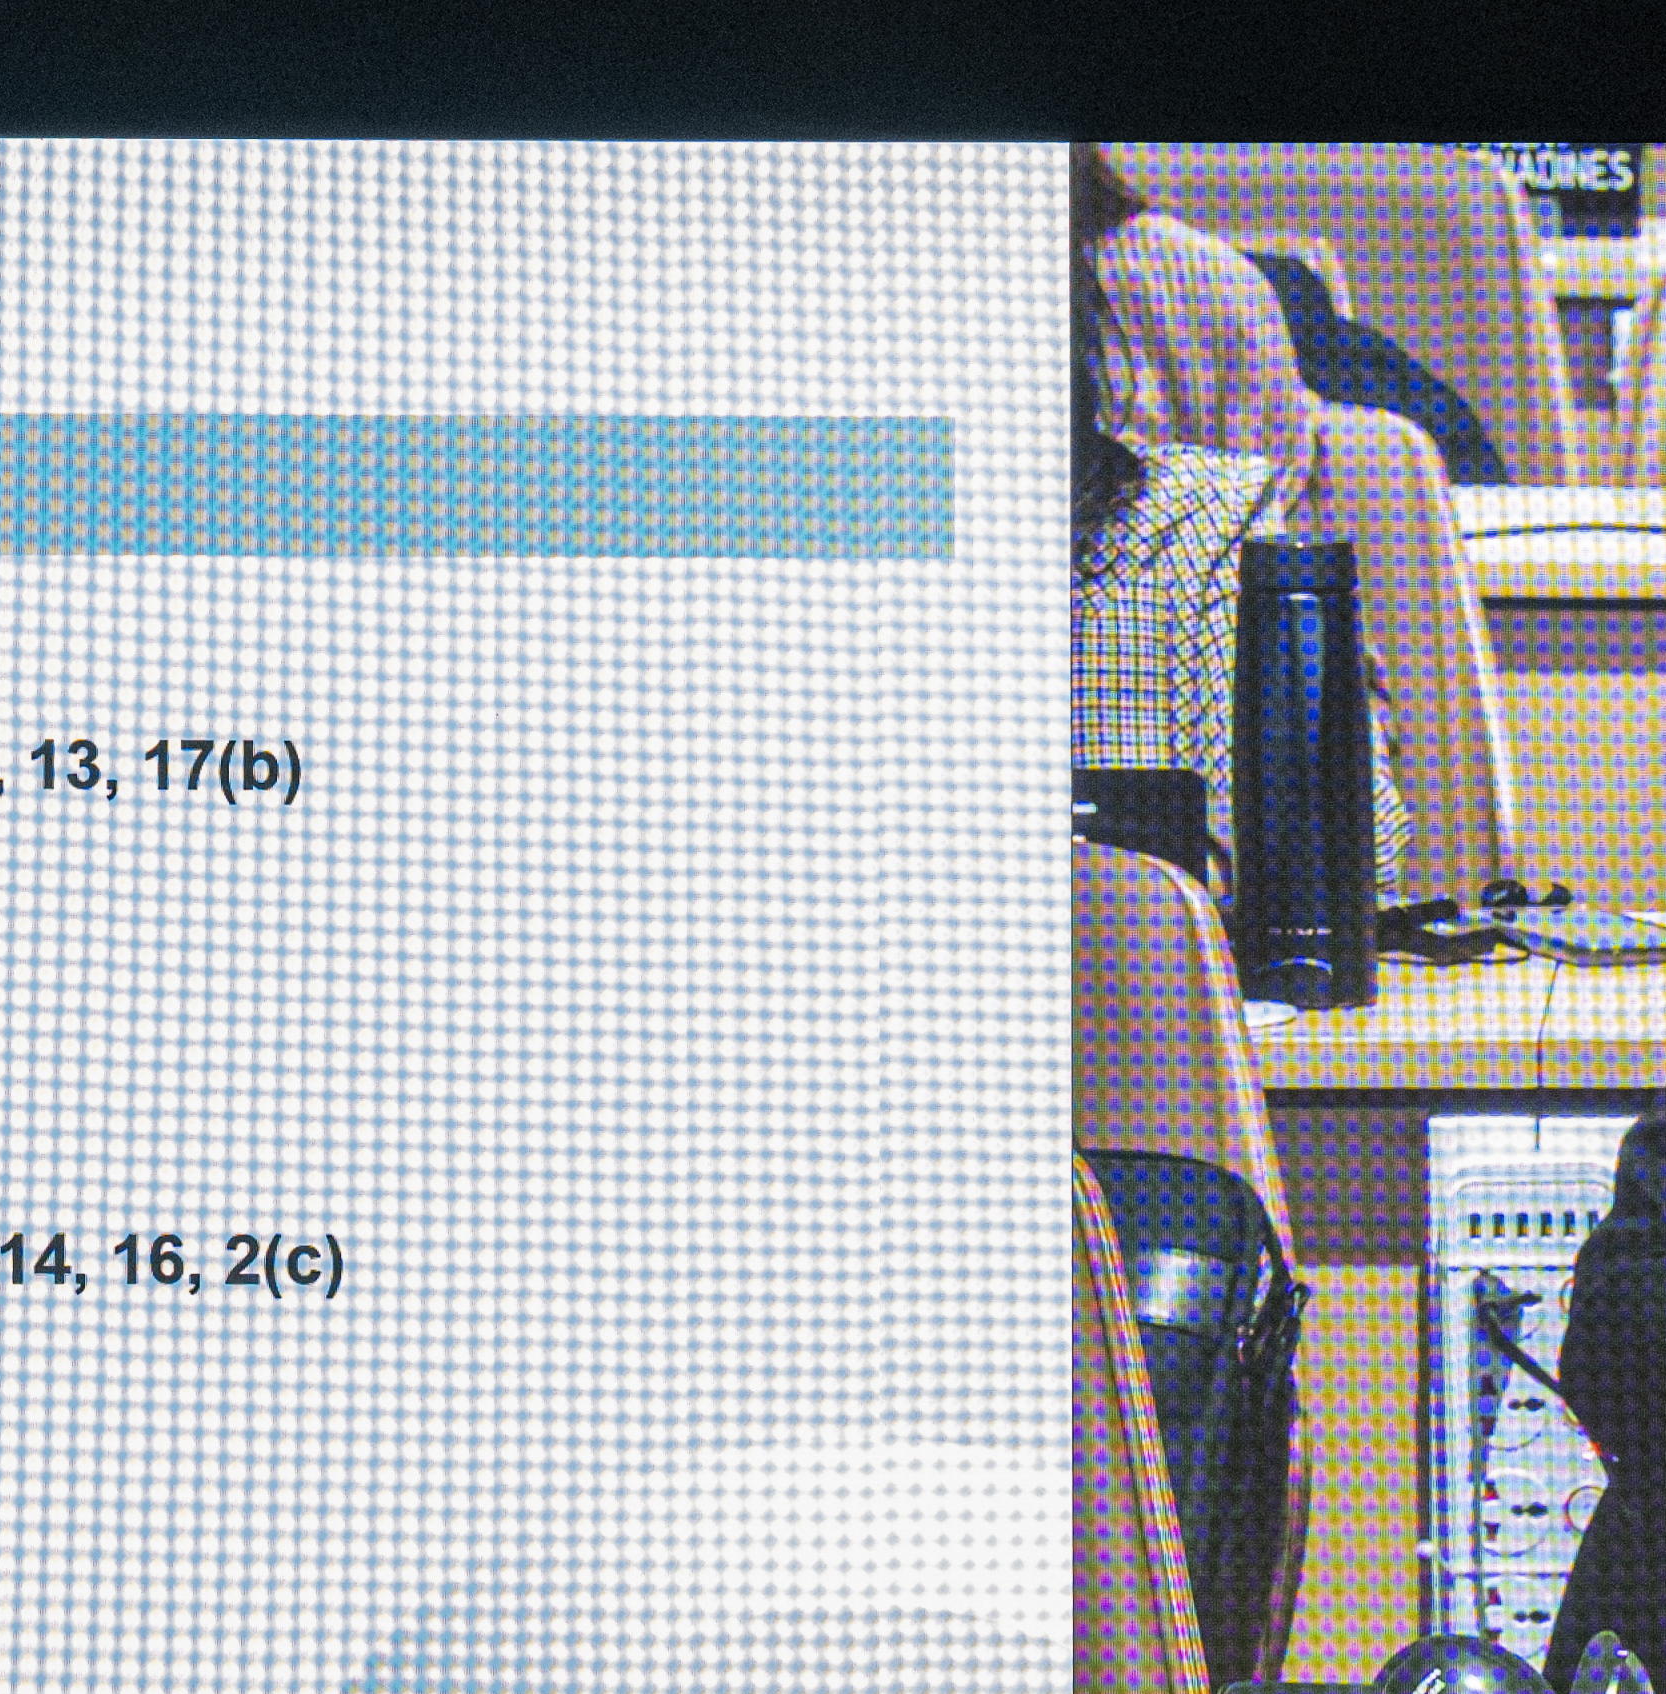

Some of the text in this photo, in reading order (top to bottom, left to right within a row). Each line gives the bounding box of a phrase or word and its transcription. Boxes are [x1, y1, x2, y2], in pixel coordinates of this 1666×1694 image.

[32, 740, 117, 800] 13,
[146, 740, 300, 804] 17(b)
[1, 1234, 85, 1294] 14,
[115, 1234, 200, 1294] 16,
[226, 1235, 342, 1298] 2(c)
